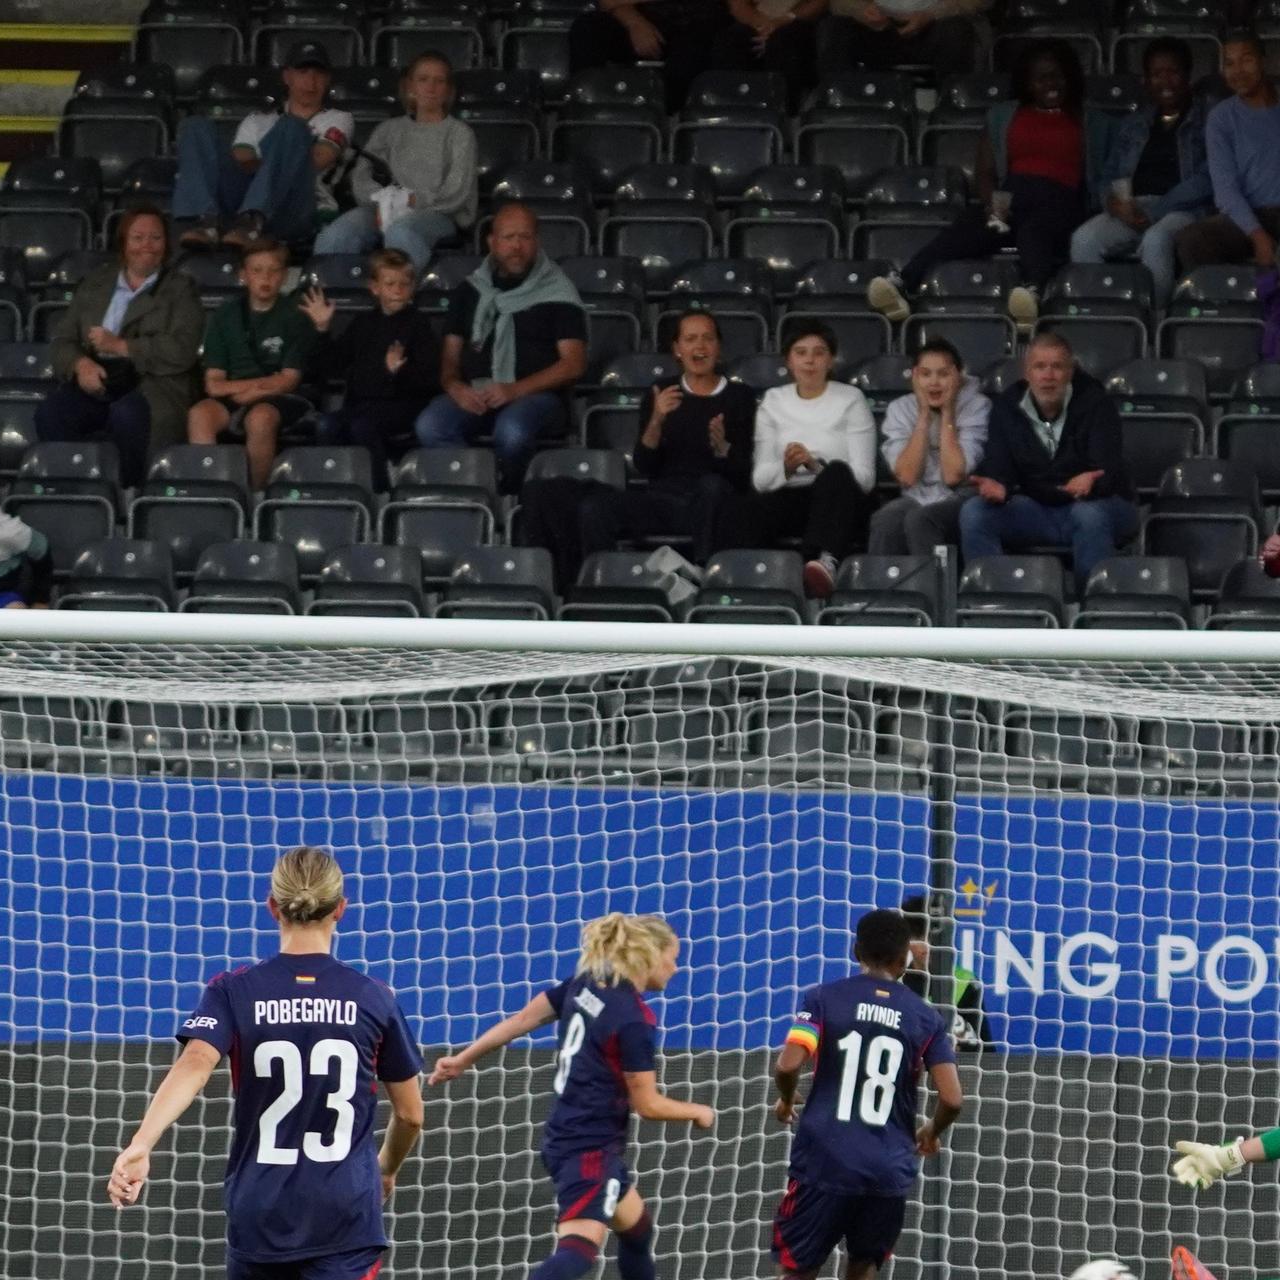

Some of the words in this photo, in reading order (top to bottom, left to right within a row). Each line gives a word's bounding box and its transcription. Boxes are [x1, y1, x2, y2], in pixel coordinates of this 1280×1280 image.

[962, 929, 1120, 998] ING
[254, 997, 358, 1026] POBEGAYLO
[856, 1003, 903, 1030] AYINDE
[254, 1038, 359, 1165] 23
[836, 1030, 904, 1126] 18
[603, 1177, 621, 1218] 8
